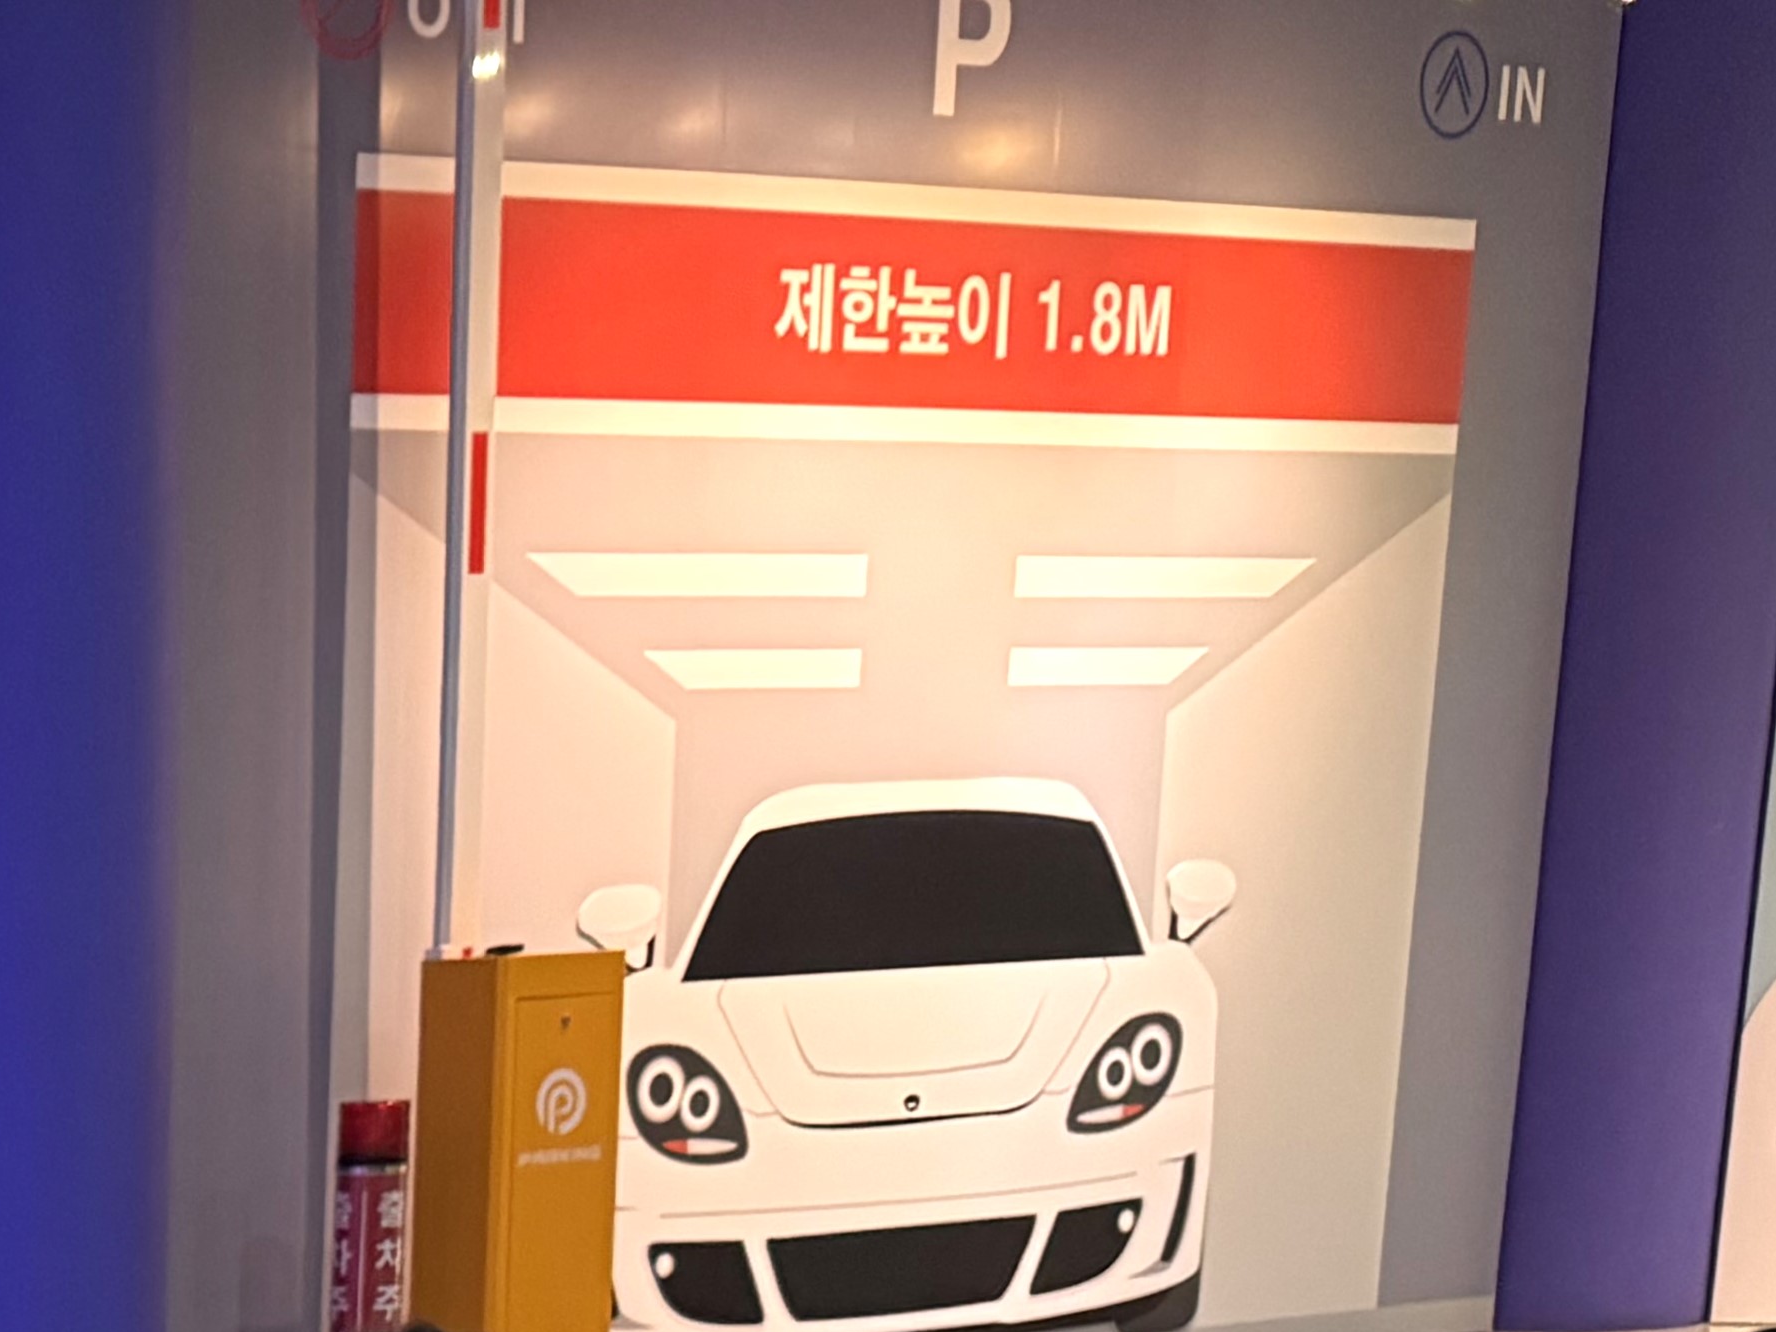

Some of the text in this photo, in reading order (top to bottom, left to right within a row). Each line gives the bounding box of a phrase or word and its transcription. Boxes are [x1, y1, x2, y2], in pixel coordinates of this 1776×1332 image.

[1498, 64, 1546, 124] IN
[773, 262, 1173, 361] 제한높이 1.8M
